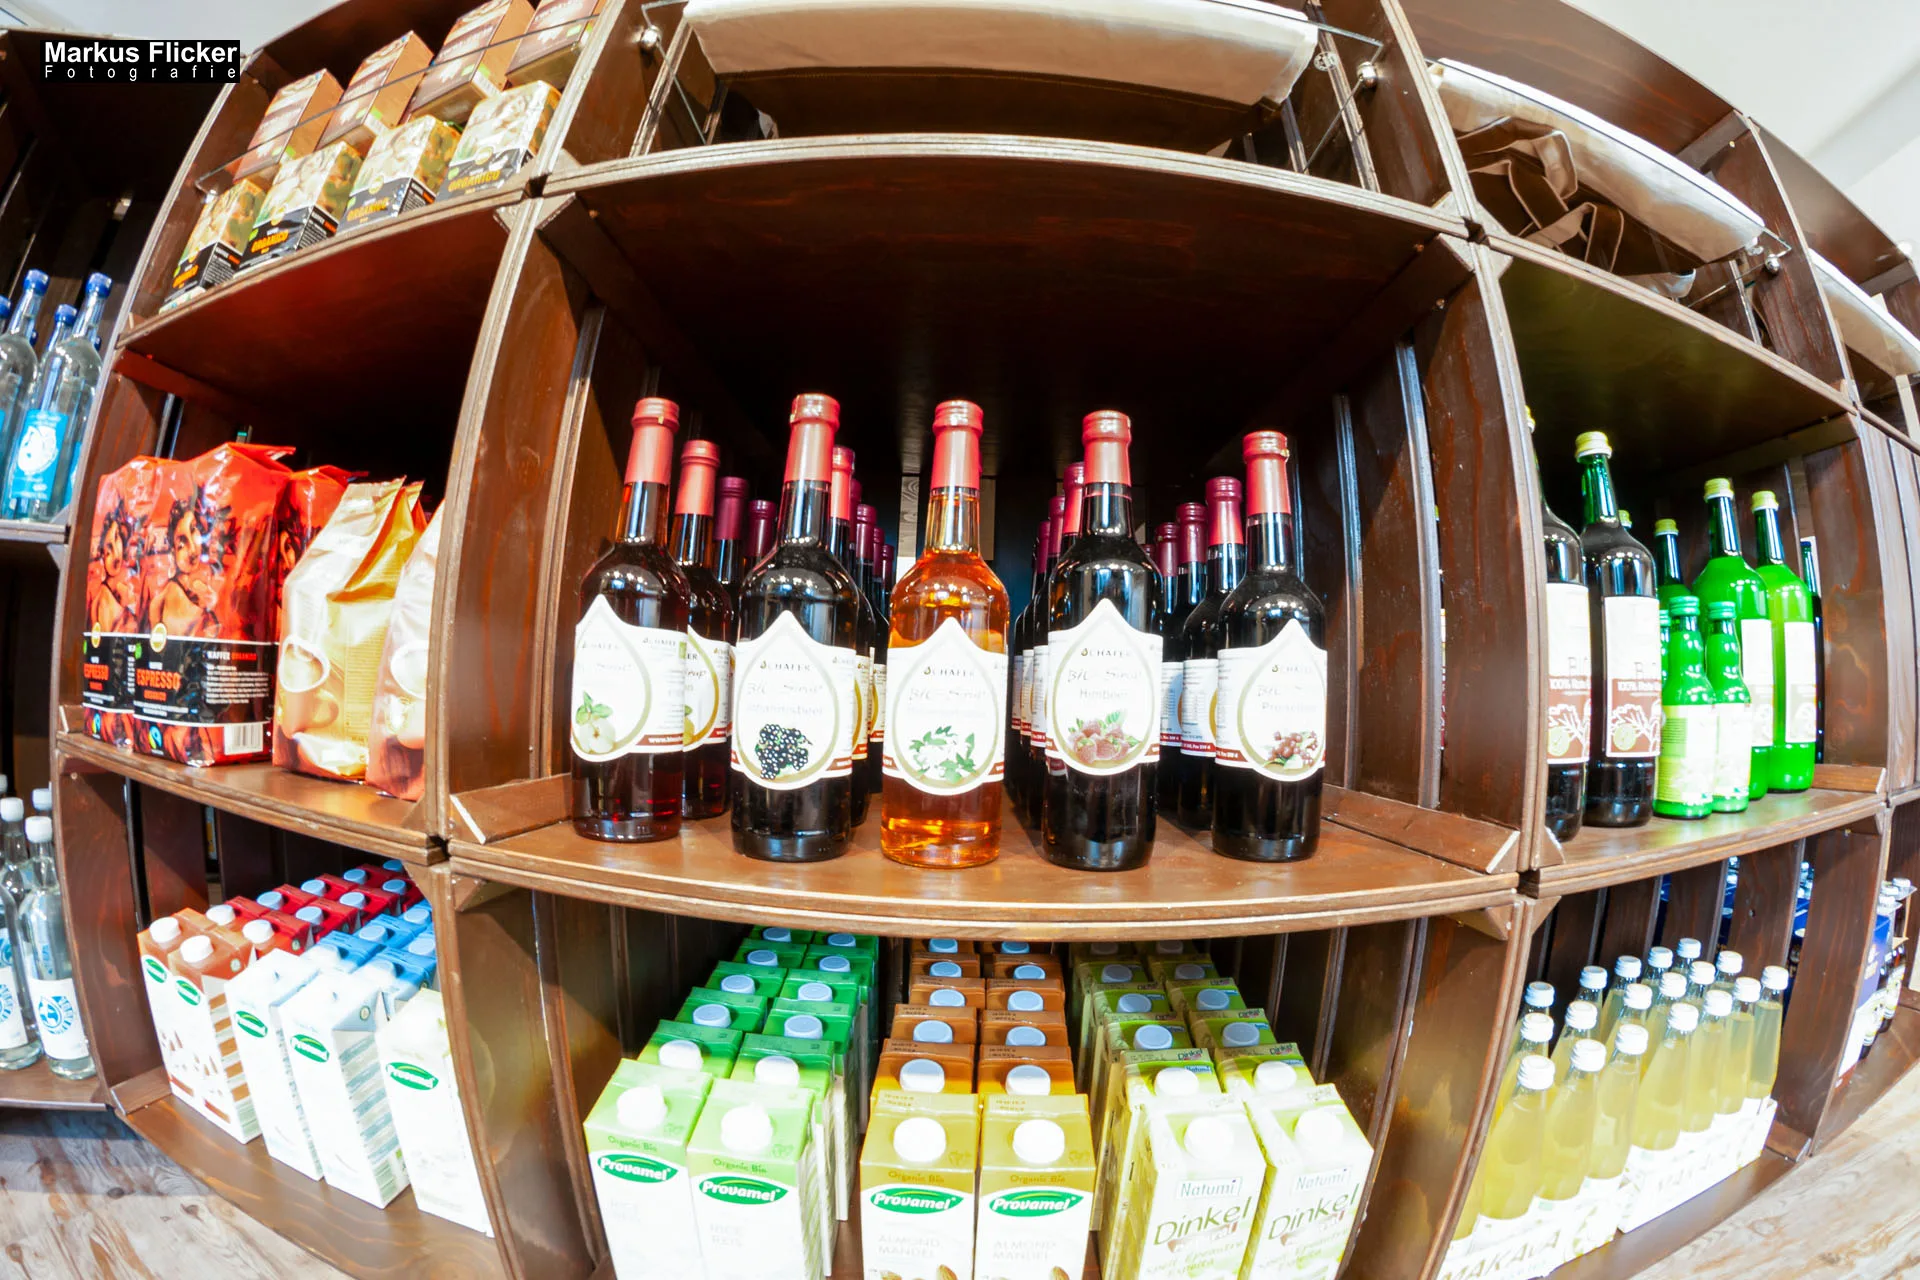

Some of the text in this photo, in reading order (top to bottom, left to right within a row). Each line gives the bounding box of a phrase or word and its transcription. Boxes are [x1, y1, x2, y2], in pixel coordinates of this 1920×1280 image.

[136, 668, 181, 692] ESPRESSO
[608, 1135, 659, 1152] Organic Bio
[600, 1157, 667, 1181] Provamel
[713, 1158, 768, 1174] Organic Bio
[888, 1170, 925, 1183] Organic
[1009, 1174, 1046, 1184] Organic
[1294, 1168, 1347, 1190] Natumi
[702, 1180, 776, 1203] Provamel
[1180, 1179, 1236, 1198] Natumi
[873, 1192, 951, 1210] Provamel
[992, 1198, 1068, 1212] Provamel
[1153, 1196, 1252, 1246] Dinkel
[1267, 1183, 1360, 1240] Dinkel
